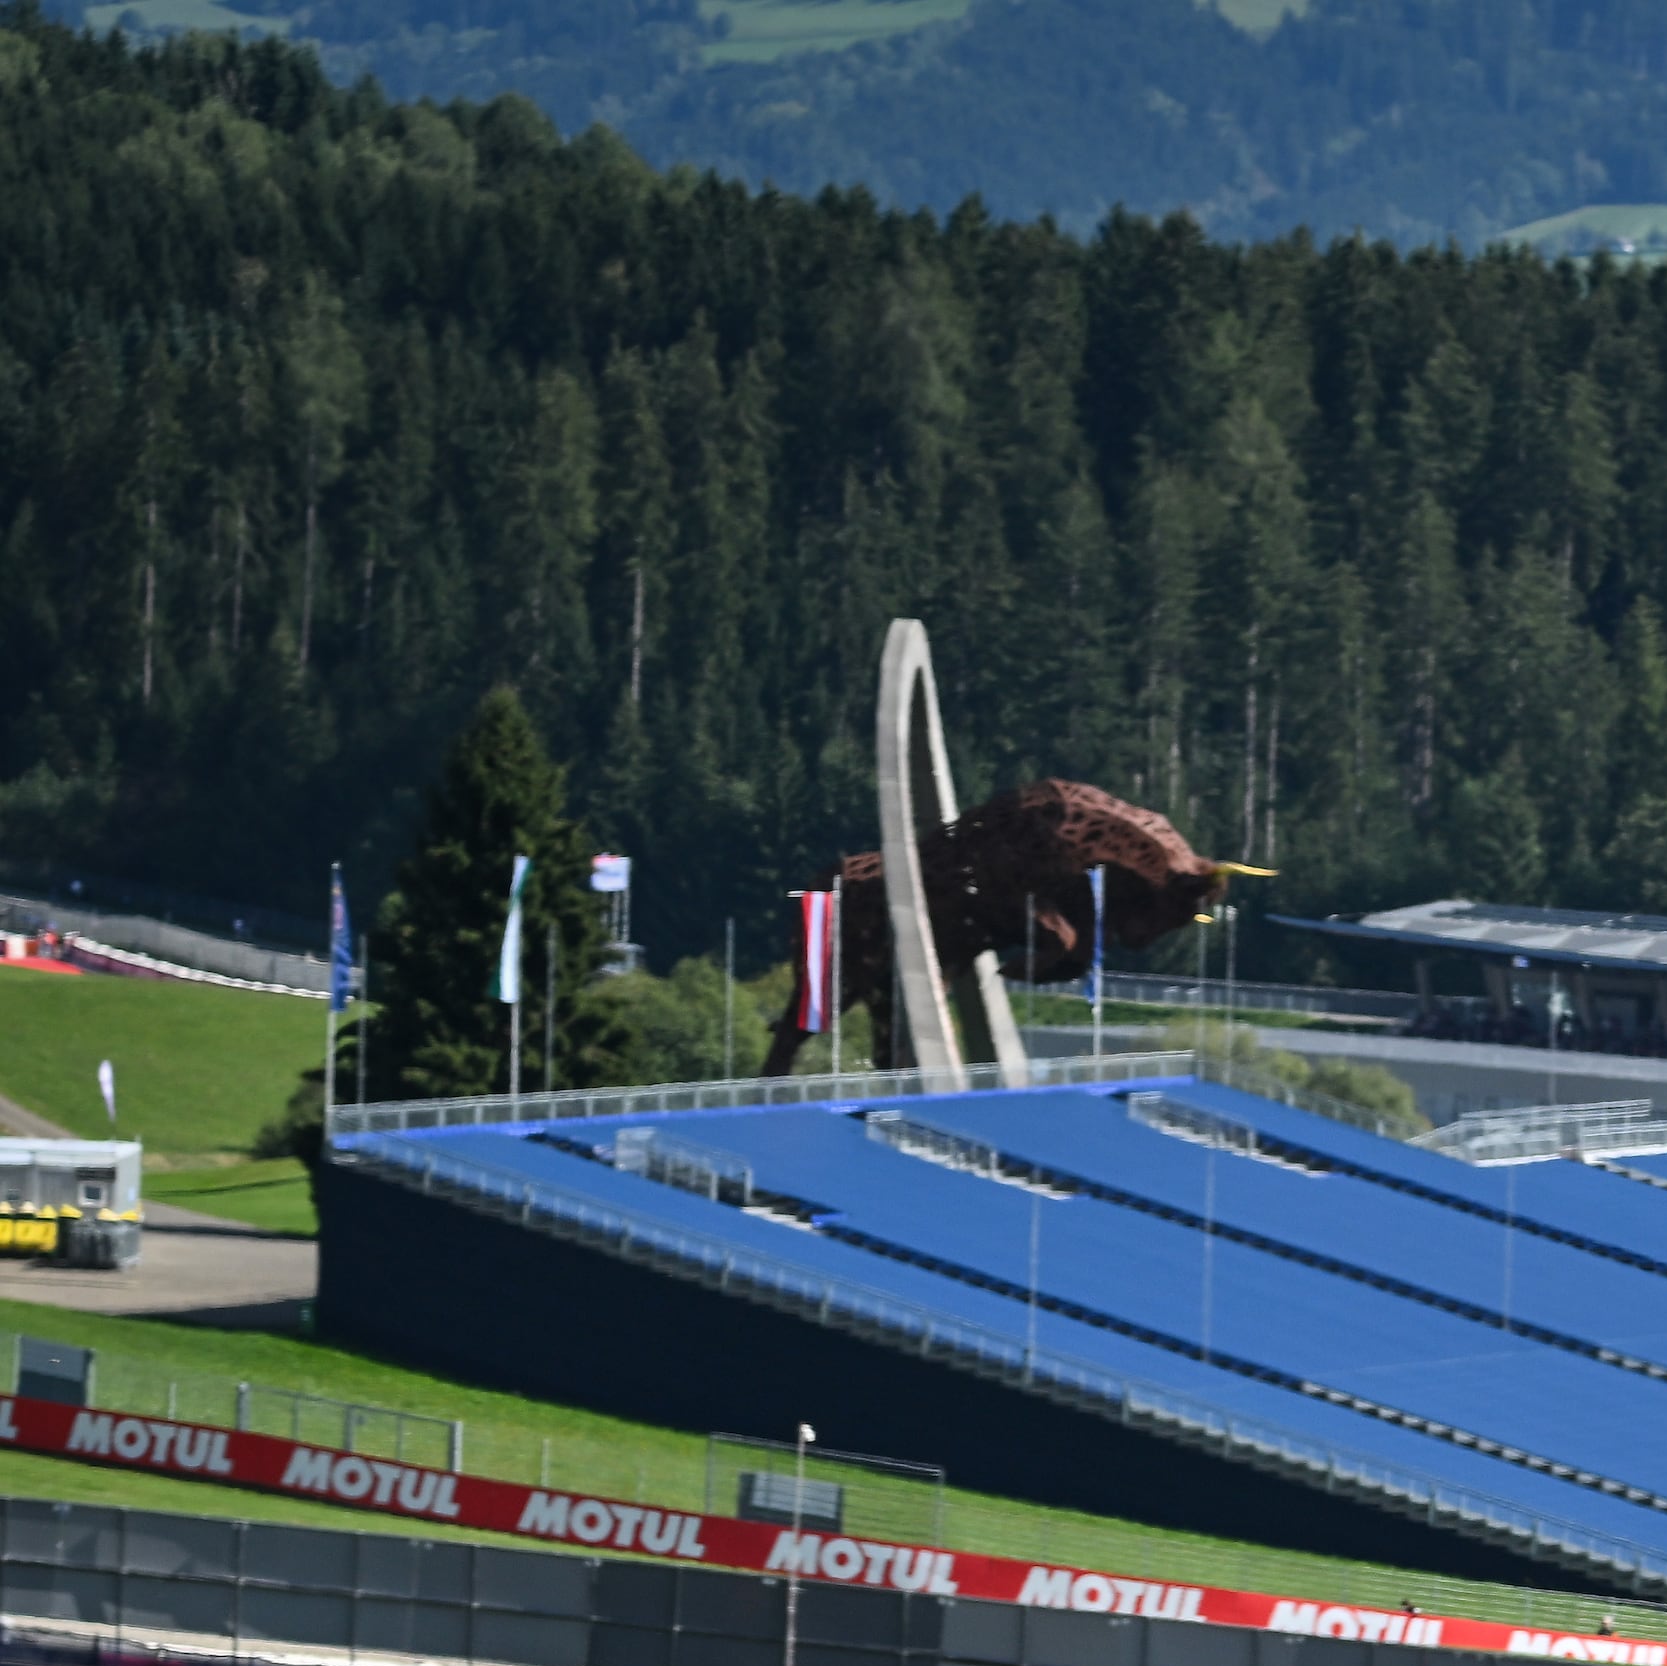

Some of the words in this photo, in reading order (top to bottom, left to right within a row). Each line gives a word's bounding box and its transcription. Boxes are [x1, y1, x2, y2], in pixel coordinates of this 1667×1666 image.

[67, 1411, 233, 1474] MOTUL
[281, 1447, 459, 1517] MOTUL
[517, 1491, 706, 1558] MOTUL
[764, 1530, 960, 1596] MOTUL
[1017, 1565, 1207, 1623] MOTUL
